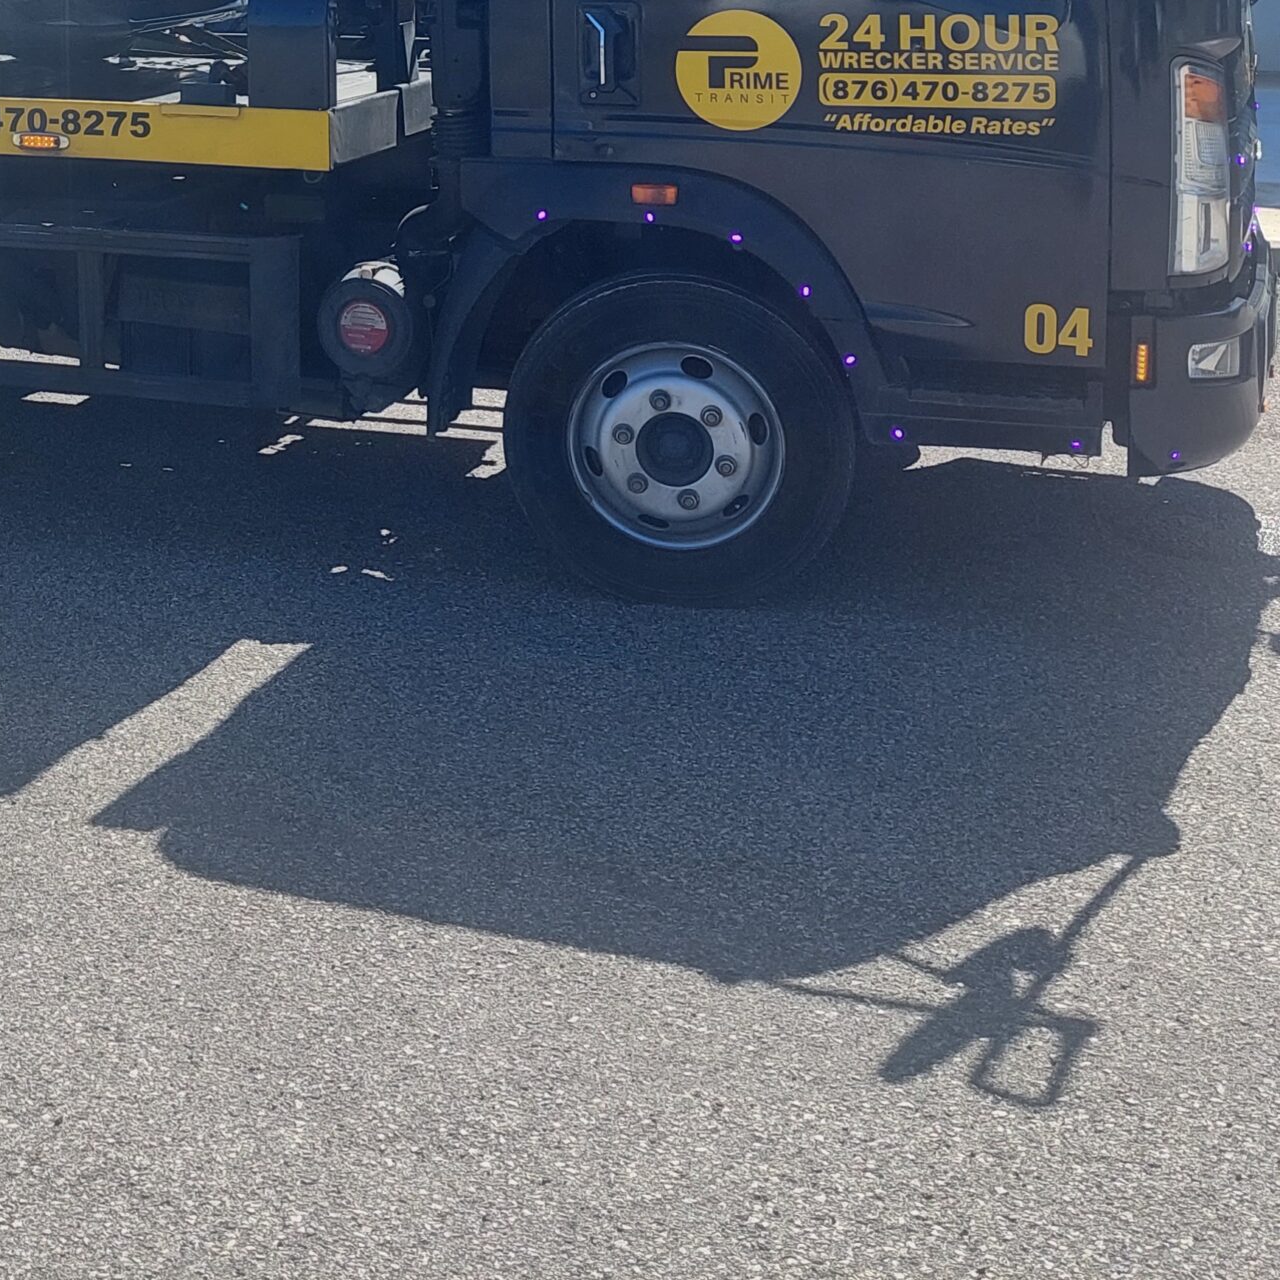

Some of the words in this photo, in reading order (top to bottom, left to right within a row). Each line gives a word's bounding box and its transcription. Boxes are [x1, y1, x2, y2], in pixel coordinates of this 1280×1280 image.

[818, 12, 887, 51] 24
[899, 13, 1060, 52] HOUR
[818, 51, 944, 70] WRECKER
[948, 52, 1060, 72] SERVICE
[695, 92, 790, 105] TRANSIT
[821, 76, 1052, 105] (876)470-8275
[1023, 303, 1094, 358] 04
